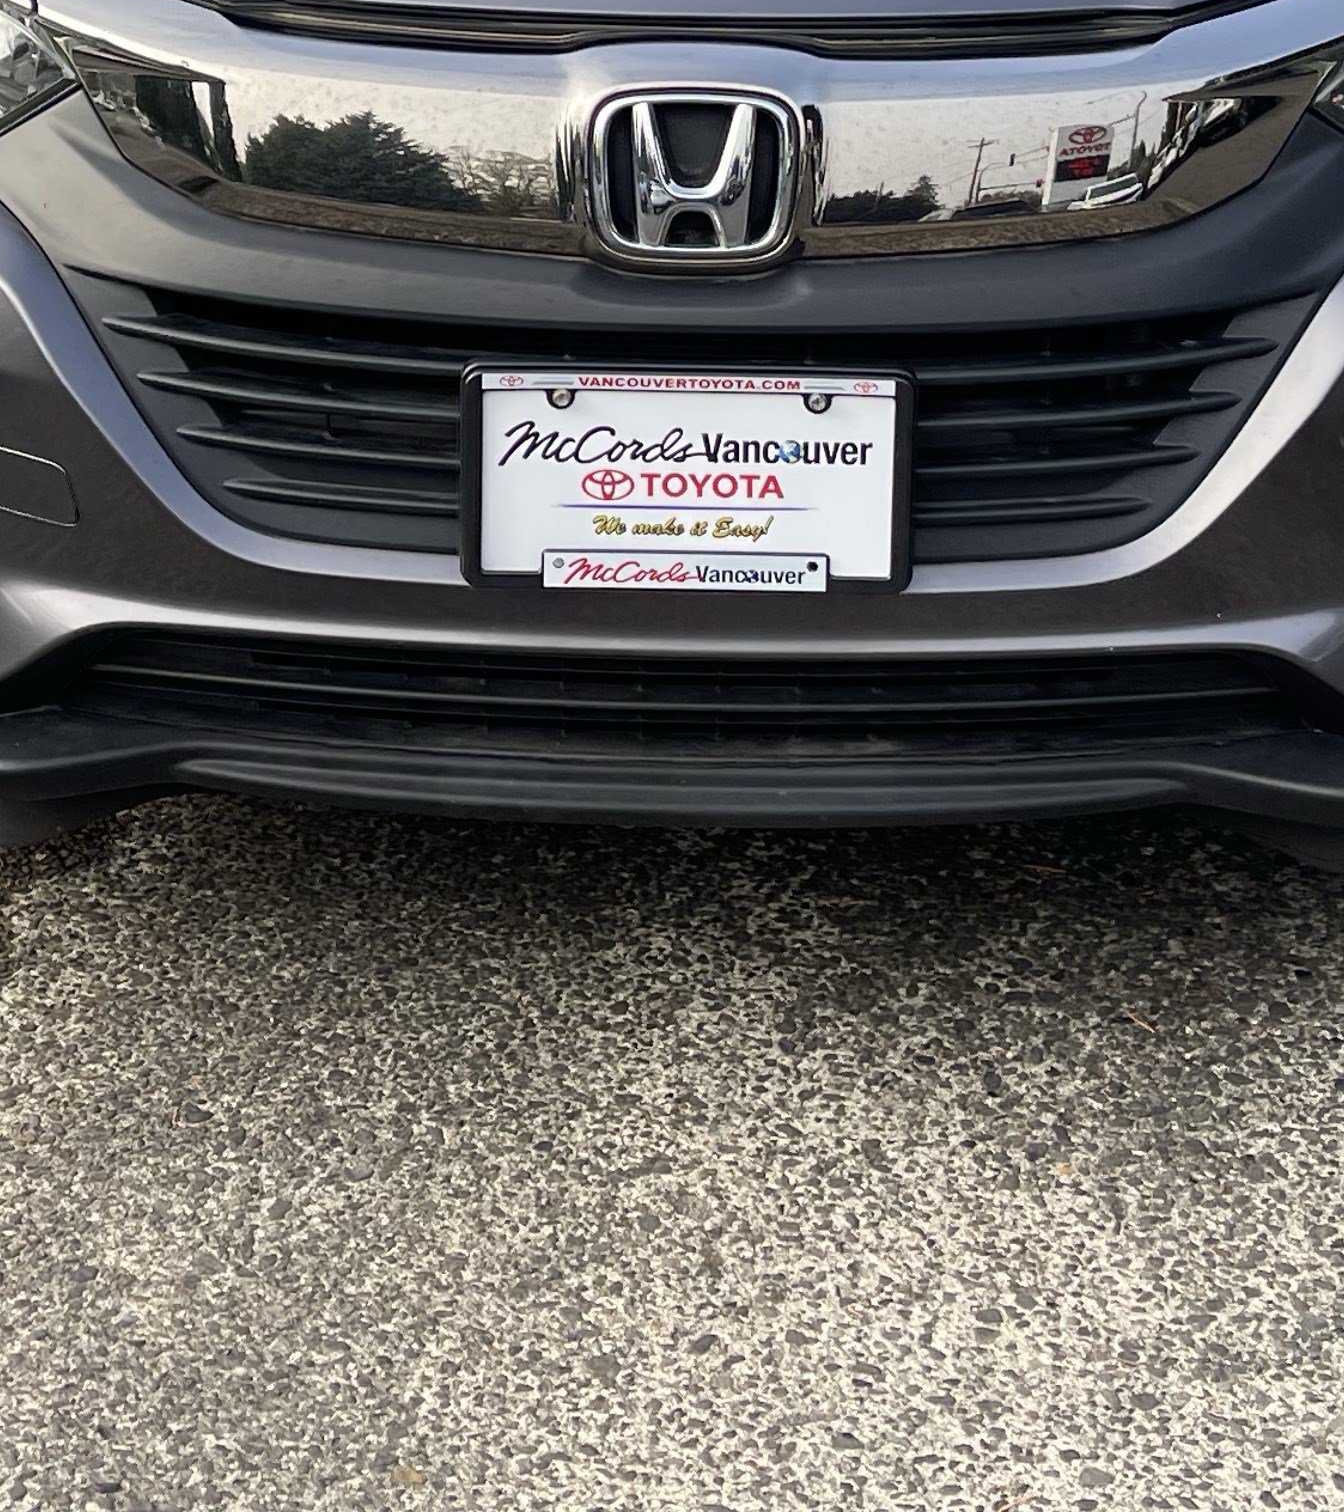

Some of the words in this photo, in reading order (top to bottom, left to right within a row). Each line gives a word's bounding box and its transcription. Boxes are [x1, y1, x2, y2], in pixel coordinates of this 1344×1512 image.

[578, 376, 802, 390] VANCOUVERTOYOTA.COM
[640, 472, 785, 500] TOYOTA
[592, 514, 627, 535] We
[631, 517, 685, 536] make
[689, 518, 708, 536] it
[712, 515, 775, 543] Easy!
